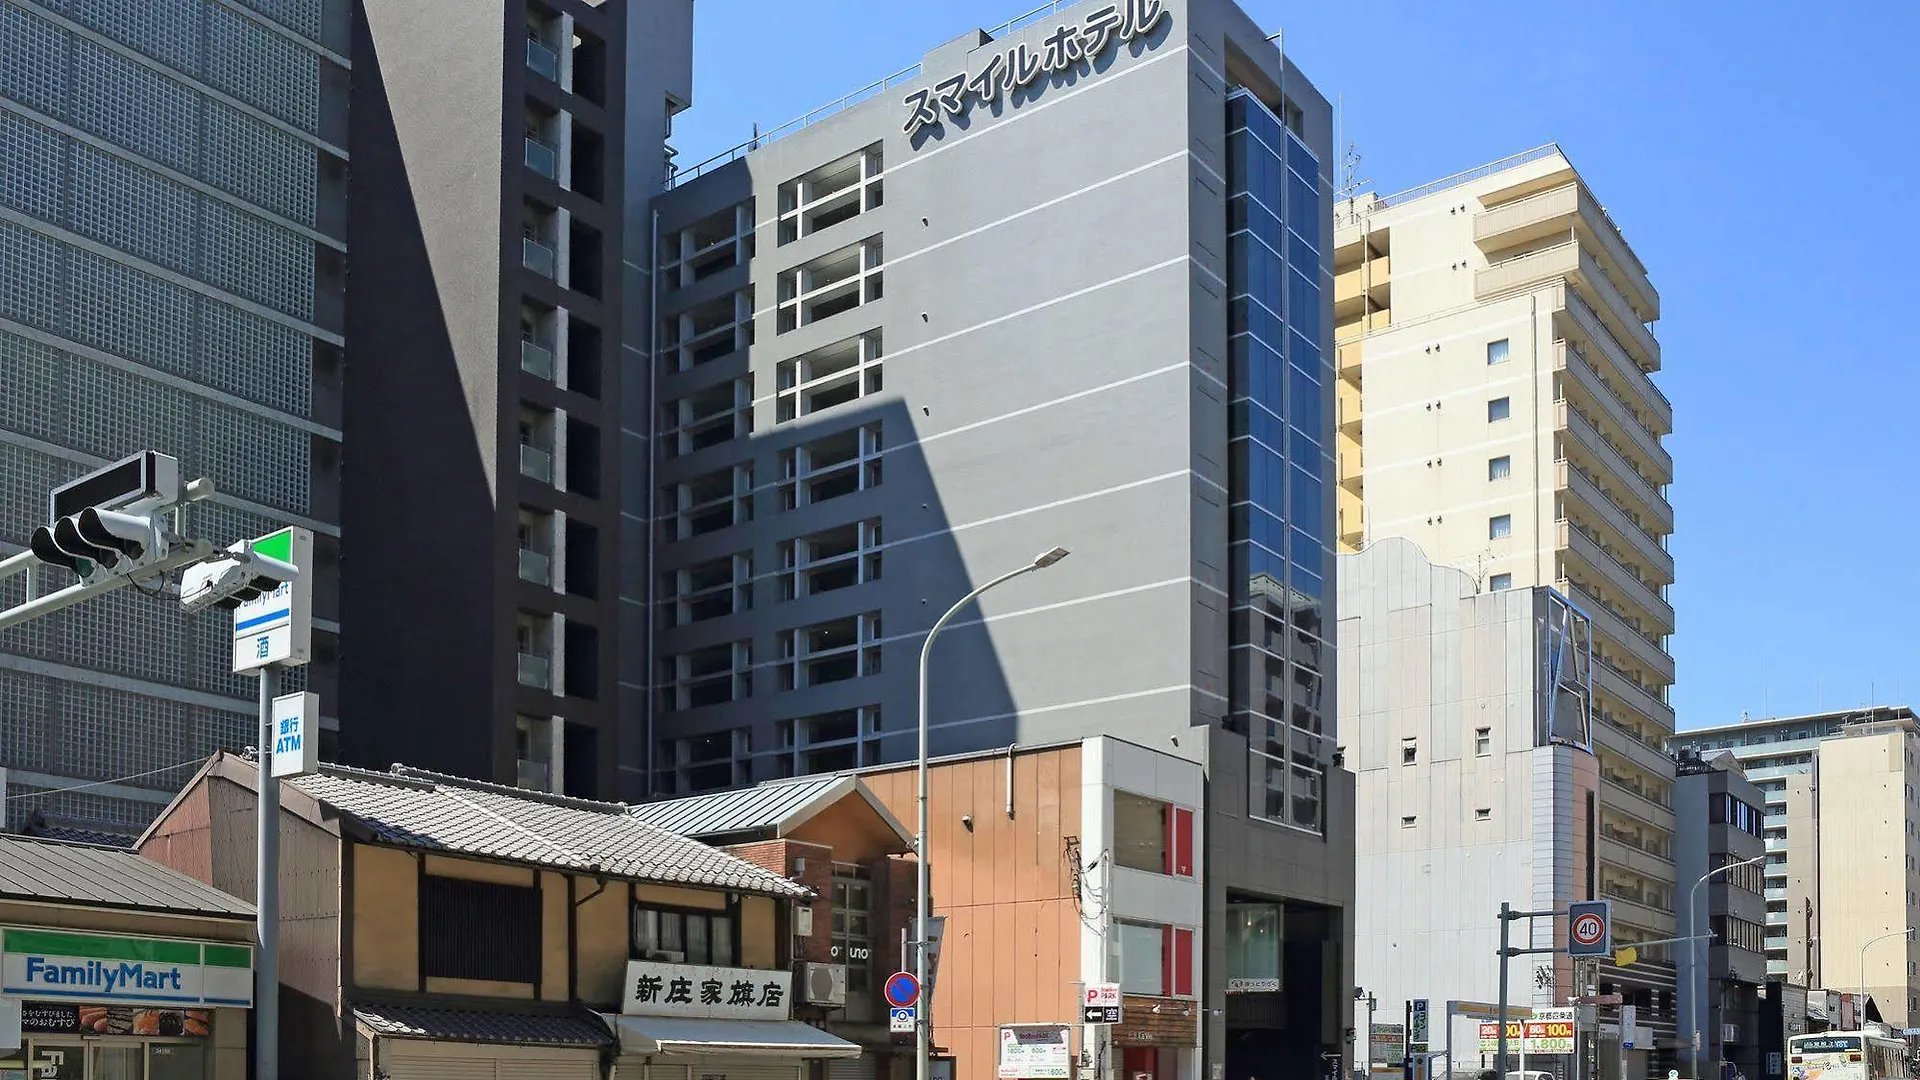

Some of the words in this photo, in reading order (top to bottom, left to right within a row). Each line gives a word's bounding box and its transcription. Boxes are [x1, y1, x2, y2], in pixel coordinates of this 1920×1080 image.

[903, 0, 1163, 134] スマイルホテル
[256, 635, 269, 659] 酒
[279, 717, 299, 736] 銀行
[276, 735, 301, 754] ATM
[1579, 921, 1597, 936] 40
[26, 956, 182, 993] FamilyMart
[635, 973, 785, 1008] 新庄家旗店
